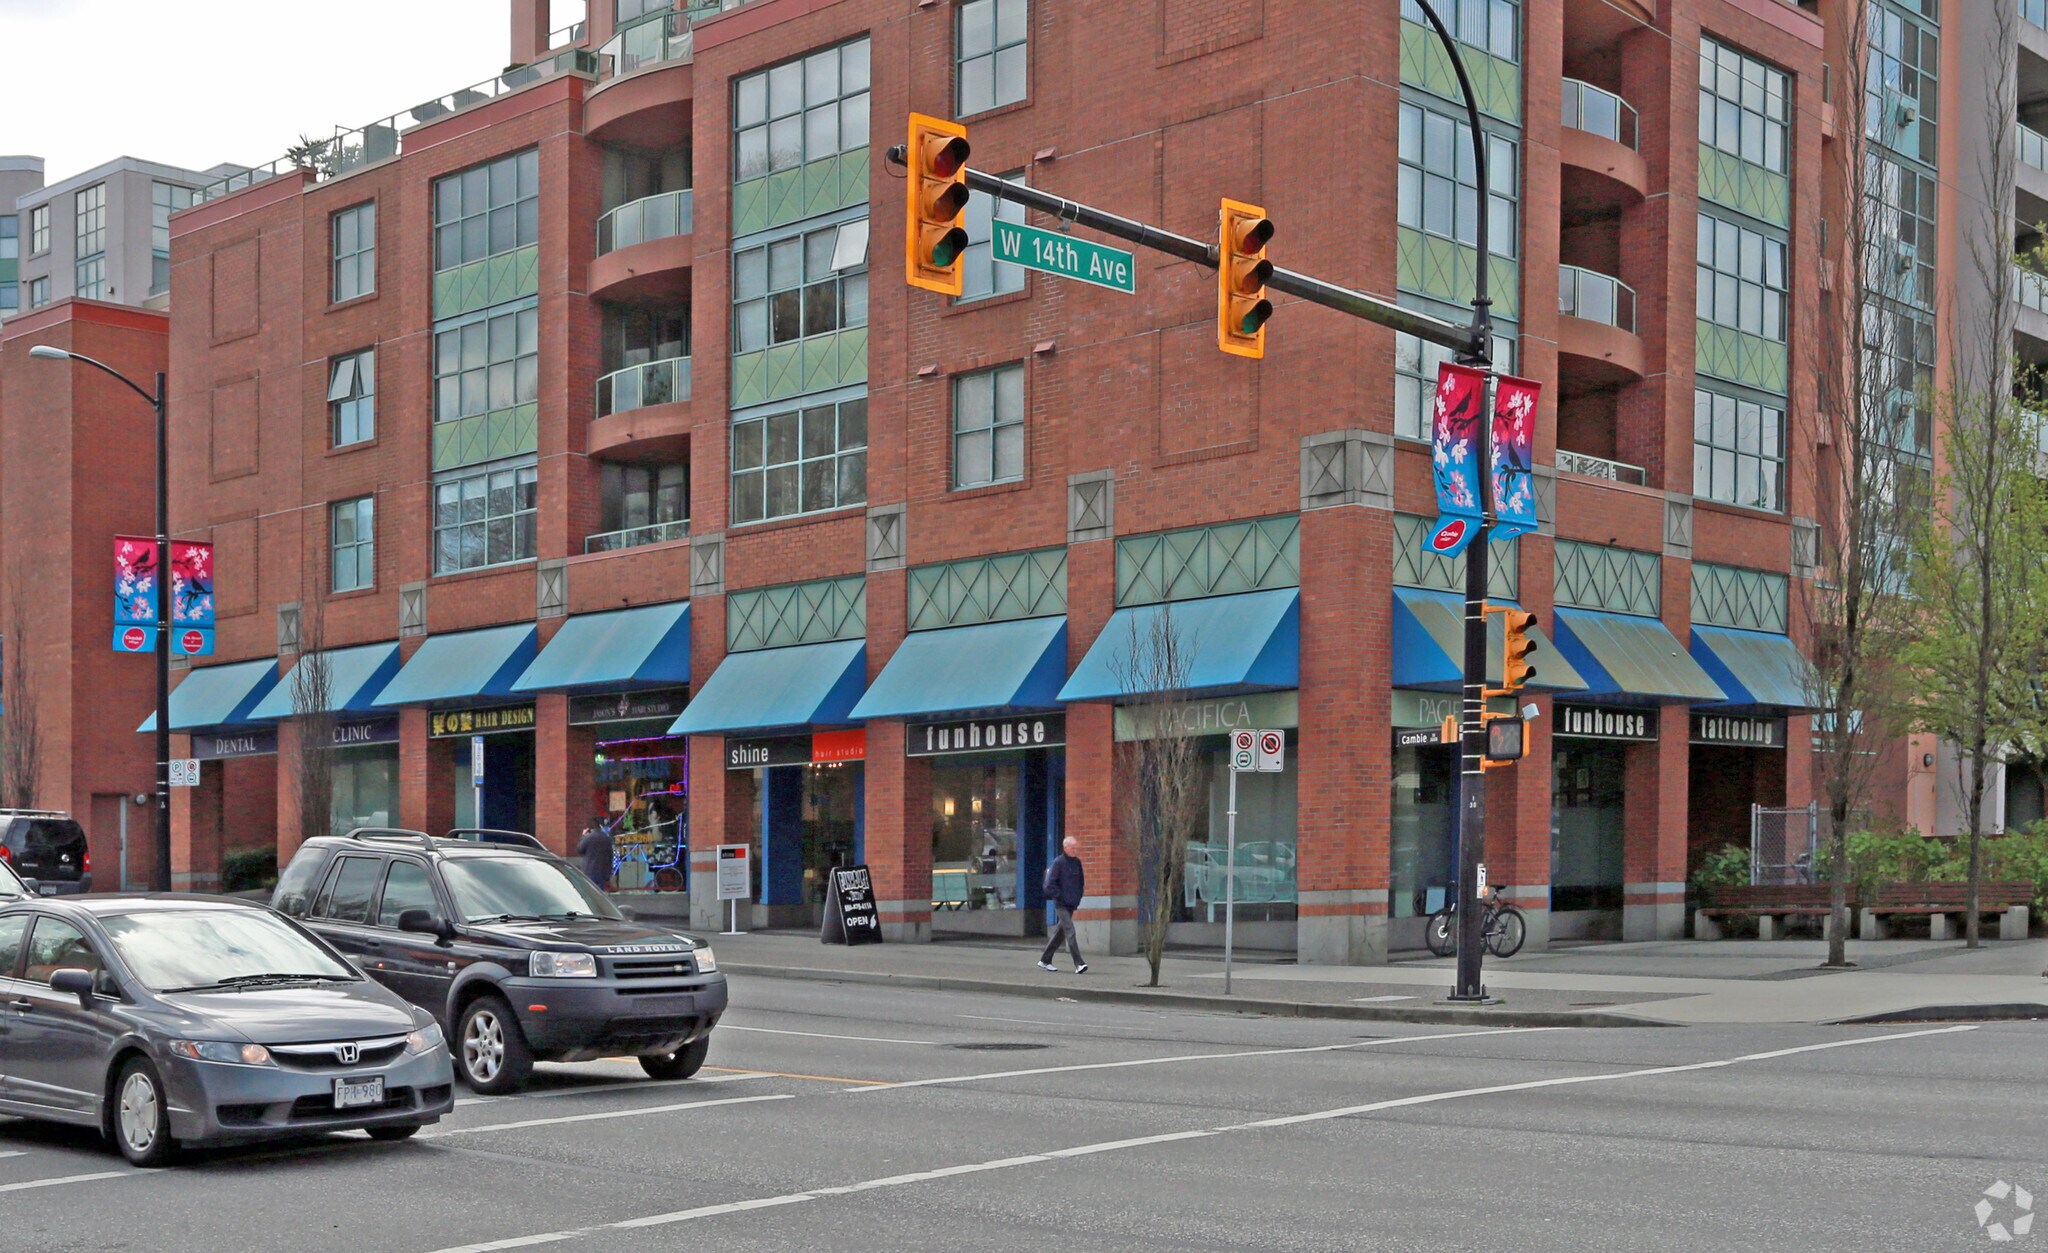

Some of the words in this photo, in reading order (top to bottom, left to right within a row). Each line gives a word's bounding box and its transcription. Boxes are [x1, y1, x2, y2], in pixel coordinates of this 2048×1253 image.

[1000, 228, 1021, 258] W
[1032, 237, 1079, 272] 14th
[1089, 252, 1127, 284] Ave
[475, 711, 498, 728] HAIR
[501, 707, 534, 726] DESIGN
[647, 703, 670, 714] STUDIO
[1159, 701, 1251, 732] PACIFICA
[1564, 707, 1645, 736] funhouse
[1701, 716, 1773, 745] tattooing
[215, 737, 257, 755] DENTAL
[332, 724, 373, 743] CLINIC
[926, 720, 1045, 751] funhouse
[1401, 733, 1428, 745] Cambie
[731, 743, 769, 765] shine
[815, 750, 832, 758] hair
[836, 747, 863, 757] studio
[846, 915, 868, 927] OPEN
